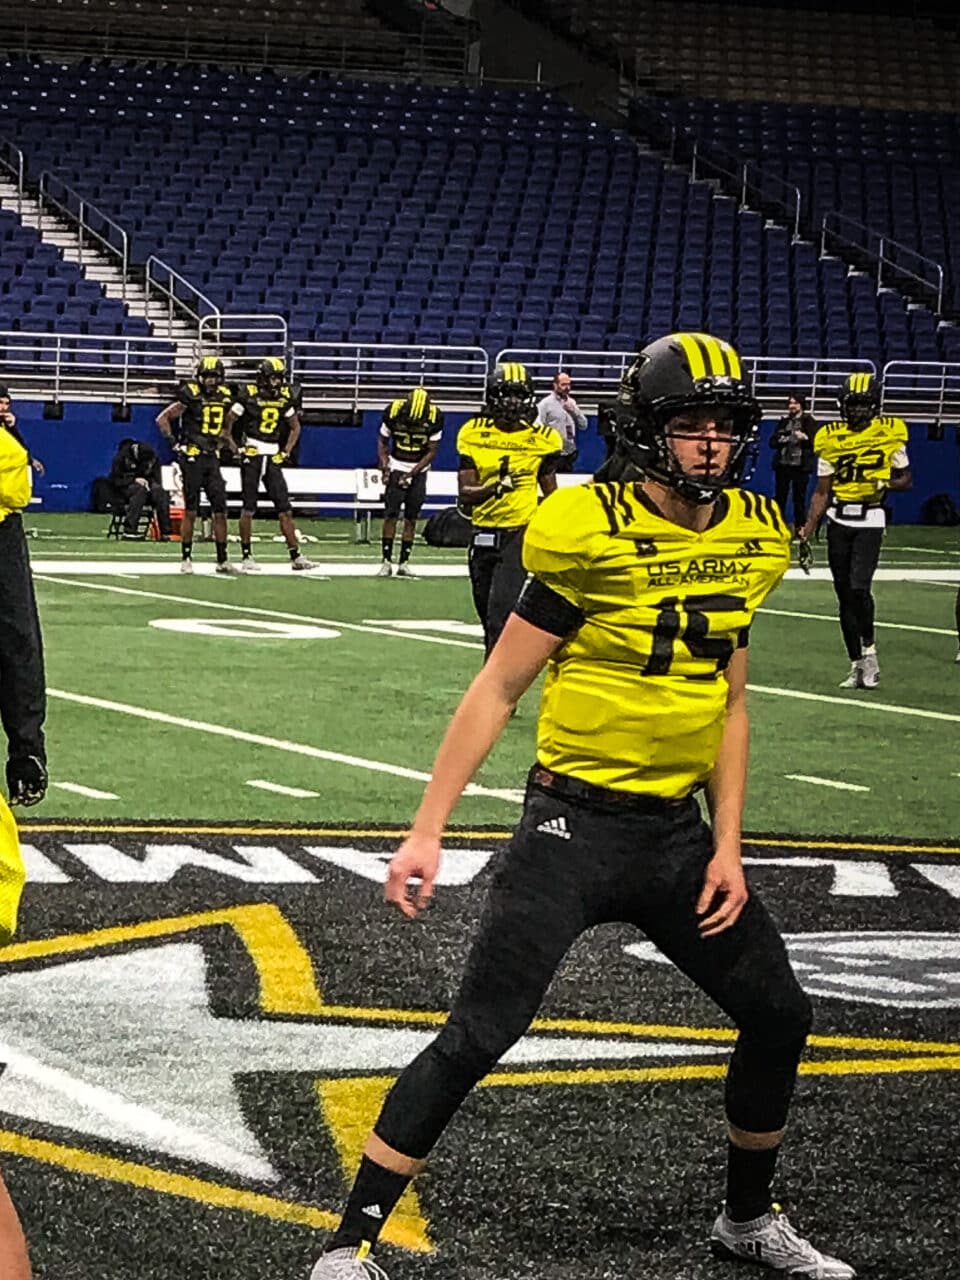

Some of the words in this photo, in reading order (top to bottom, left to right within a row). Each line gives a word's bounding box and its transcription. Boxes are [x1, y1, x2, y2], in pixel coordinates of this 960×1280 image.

[201, 406, 224, 435] 13
[259, 407, 280, 434] 8
[686, 559, 752, 575] ARMY
[641, 594, 748, 681] 15
